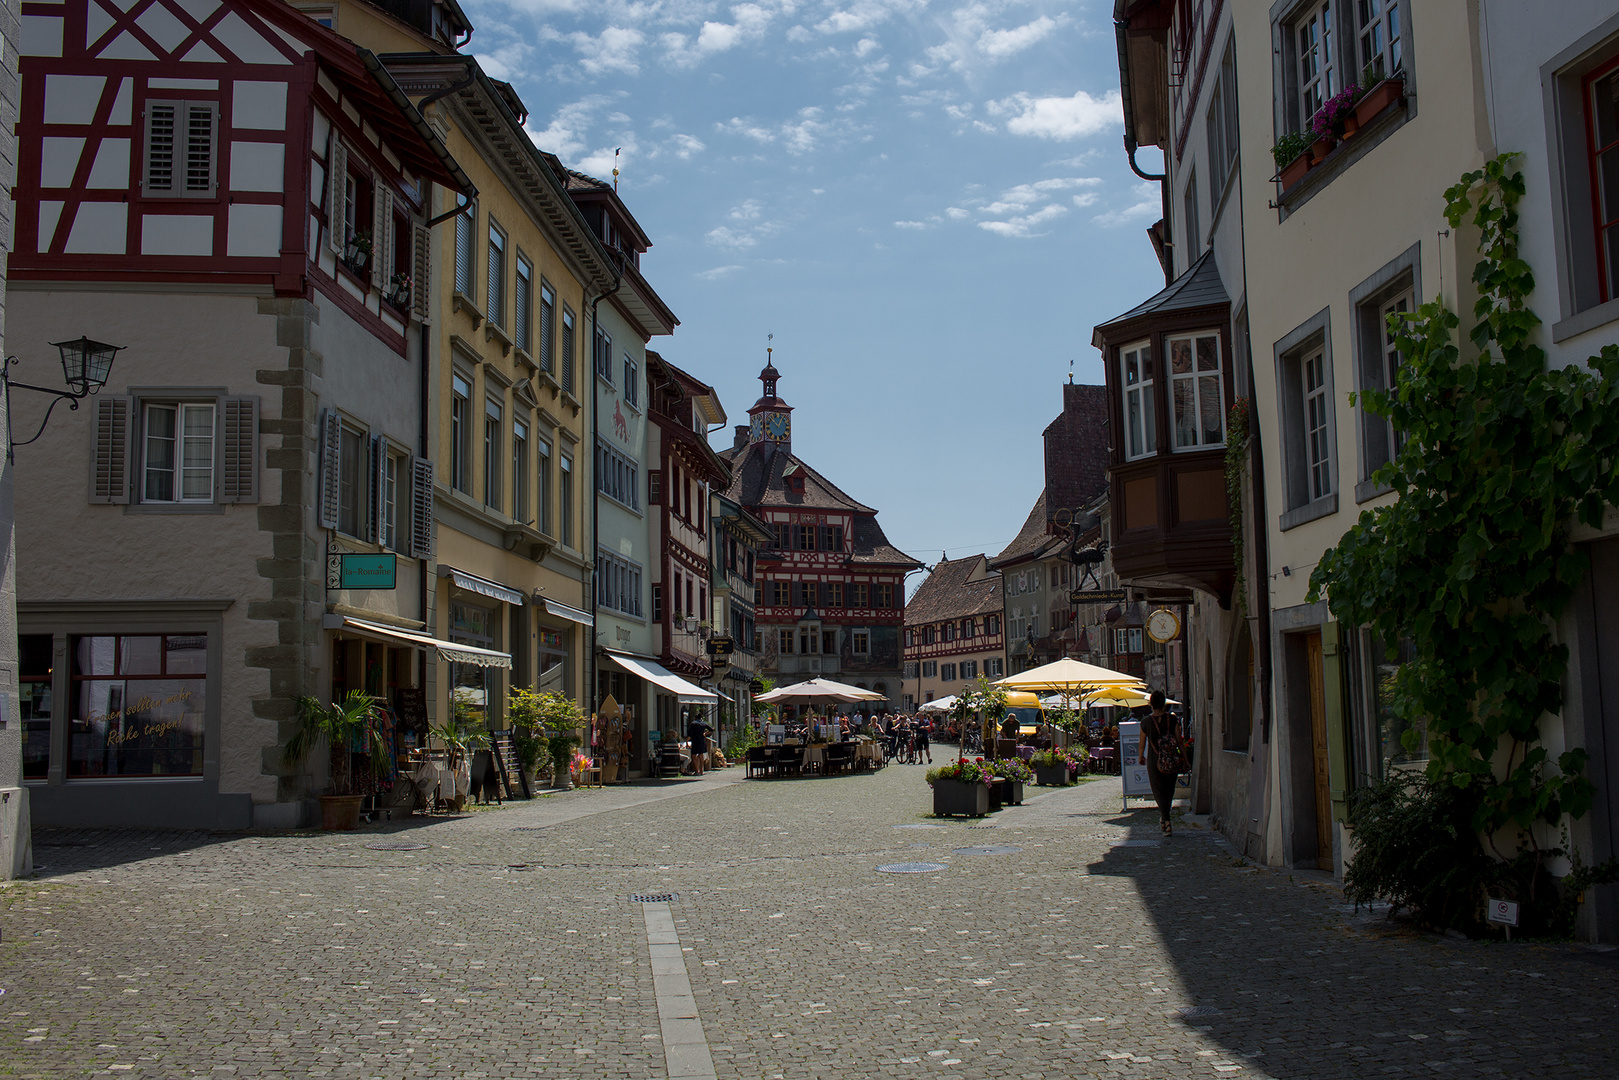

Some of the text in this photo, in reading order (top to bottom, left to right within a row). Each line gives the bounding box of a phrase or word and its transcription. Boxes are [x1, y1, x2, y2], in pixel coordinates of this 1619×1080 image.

[85, 687, 193, 727] Frauen sollten mehr
[144, 711, 185, 737] tragen!
